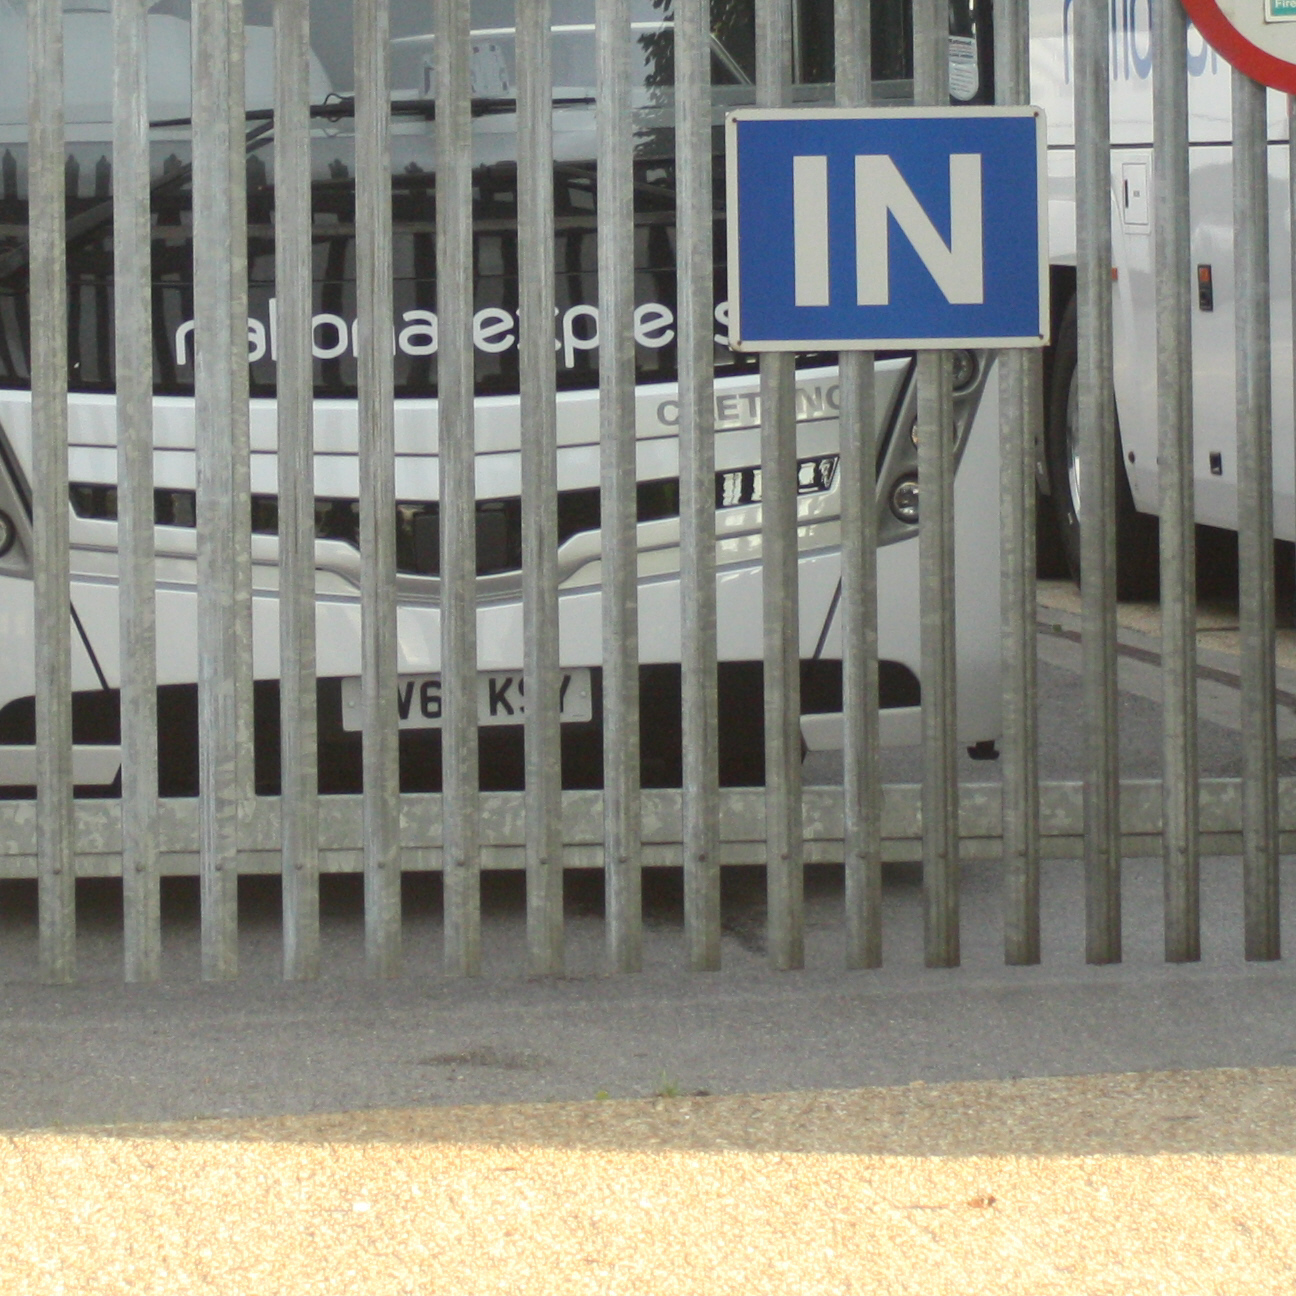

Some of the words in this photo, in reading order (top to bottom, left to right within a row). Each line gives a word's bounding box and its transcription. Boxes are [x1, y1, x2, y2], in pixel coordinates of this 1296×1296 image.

[793, 153, 984, 307] IN
[657, 384, 840, 427] CETN
[489, 674, 572, 717] KY
